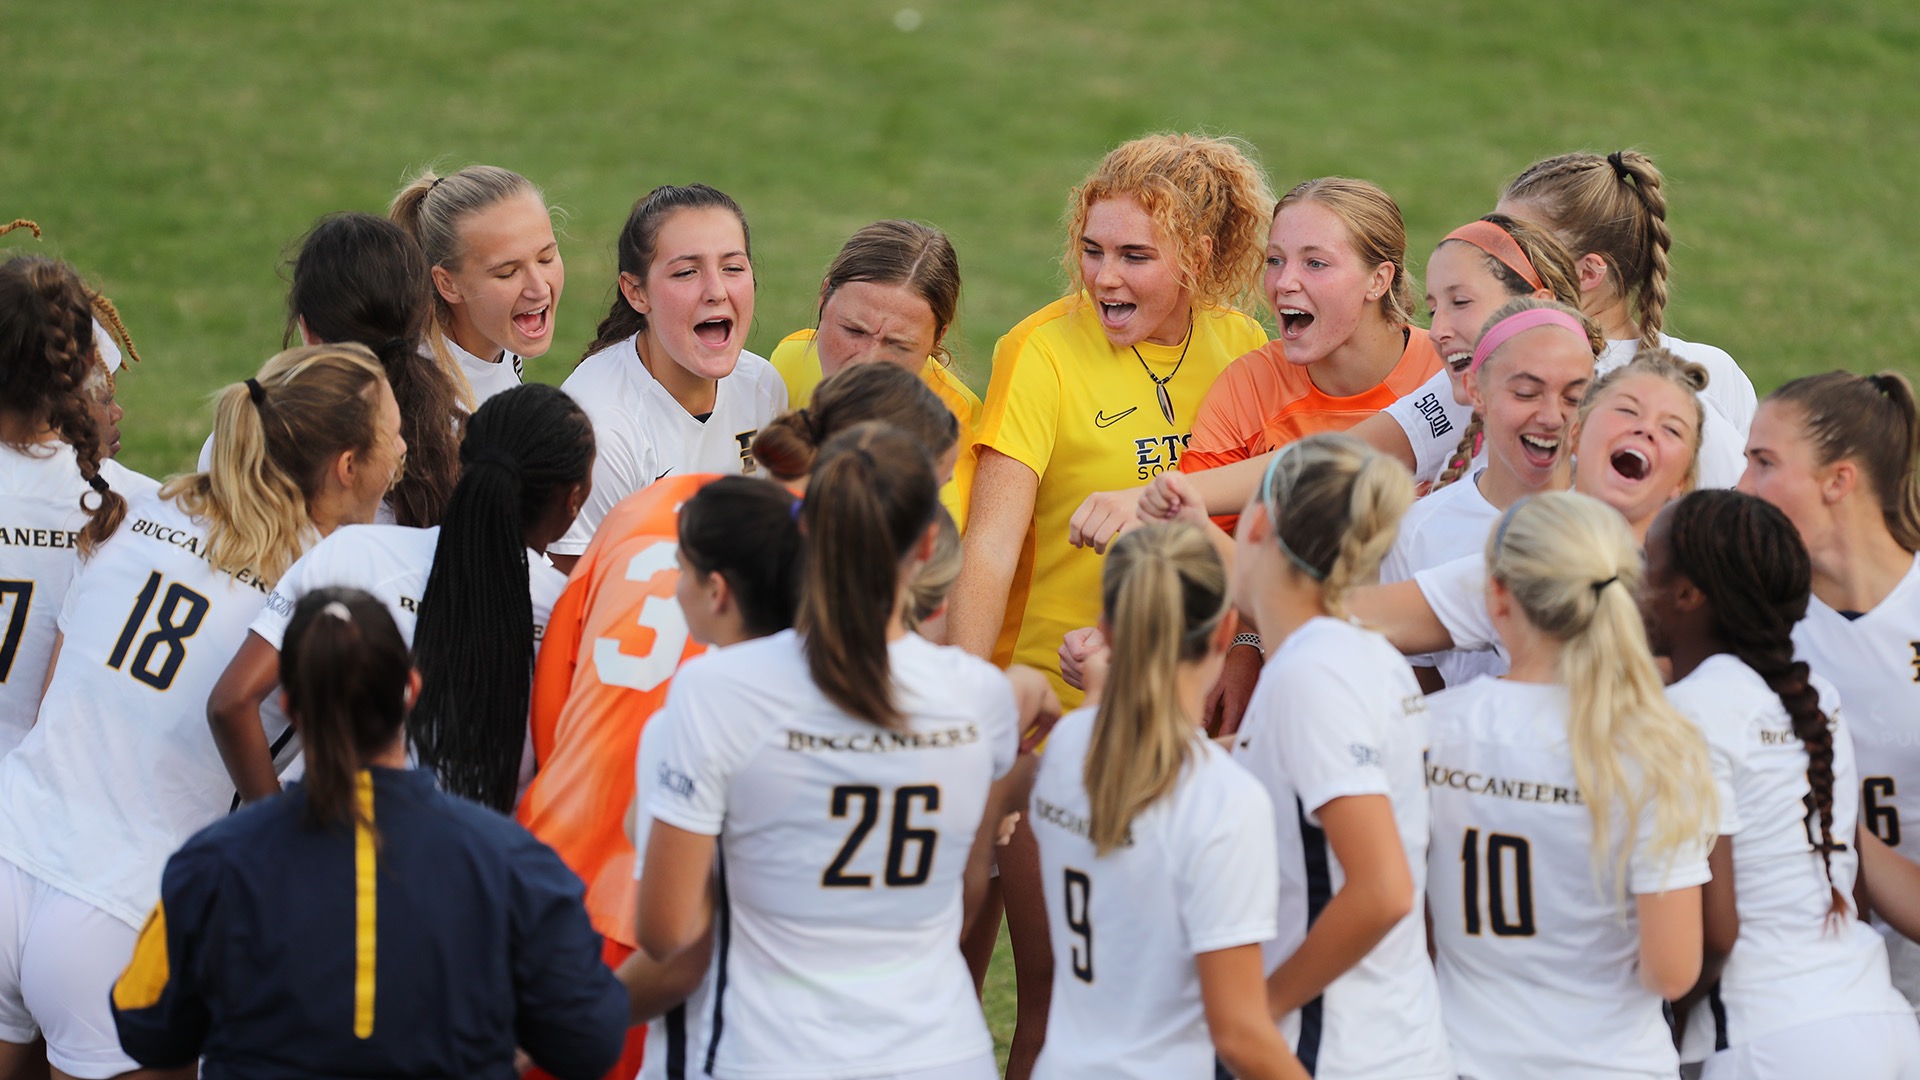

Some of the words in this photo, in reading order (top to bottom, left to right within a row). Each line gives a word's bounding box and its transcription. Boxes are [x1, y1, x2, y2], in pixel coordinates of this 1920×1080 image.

[1414, 393, 1453, 438] SOCON
[131, 519, 269, 594] BUCCAER
[0, 580, 35, 683] 7
[107, 569, 211, 690] 18
[787, 722, 978, 752] BUCCANEERS
[822, 784, 941, 888] 26
[1862, 776, 1901, 848] 6
[1064, 866, 1094, 984] 9
[1462, 828, 1536, 937] 10
